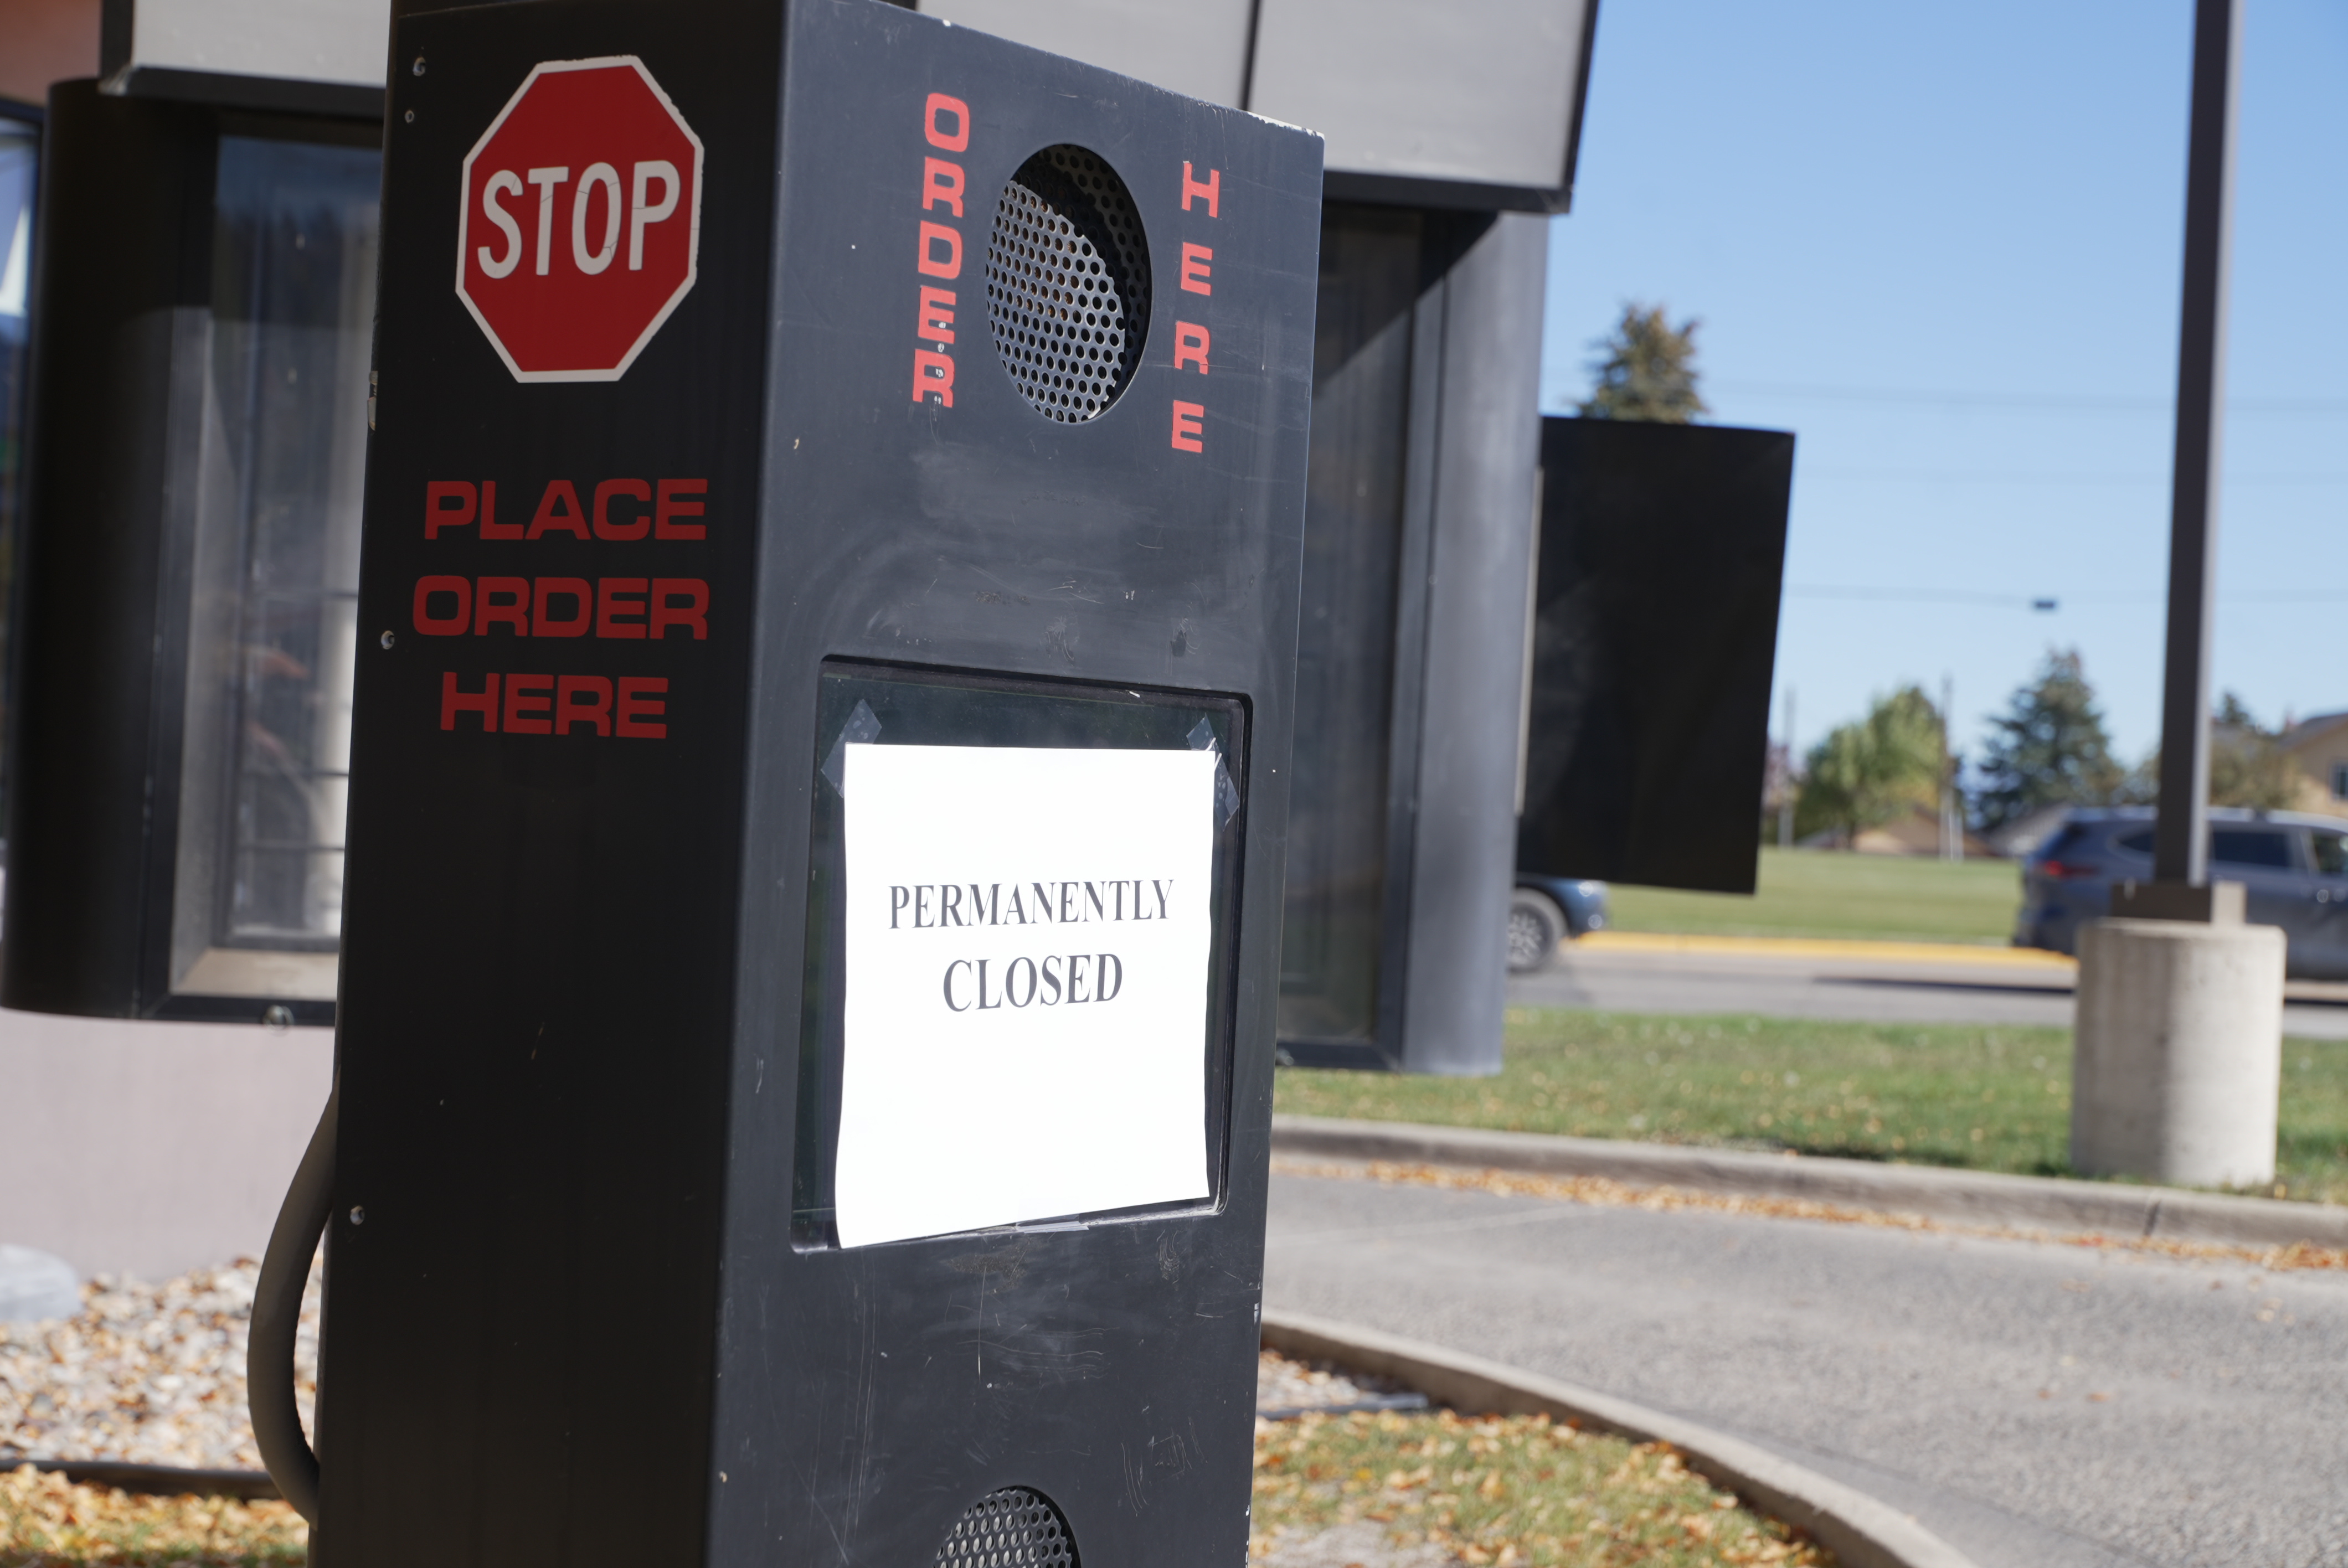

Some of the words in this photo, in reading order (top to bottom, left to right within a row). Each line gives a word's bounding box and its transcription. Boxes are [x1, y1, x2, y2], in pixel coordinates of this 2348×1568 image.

[477, 159, 681, 279] STOP
[912, 92, 970, 408] ORDER
[1171, 161, 1220, 453] HERE
[425, 478, 708, 541] PLACE
[413, 575, 710, 640] ORDER
[440, 672, 669, 739] HERE
[889, 879, 1174, 929] PERMANENTLY
[943, 953, 1123, 1012] CLOSED
